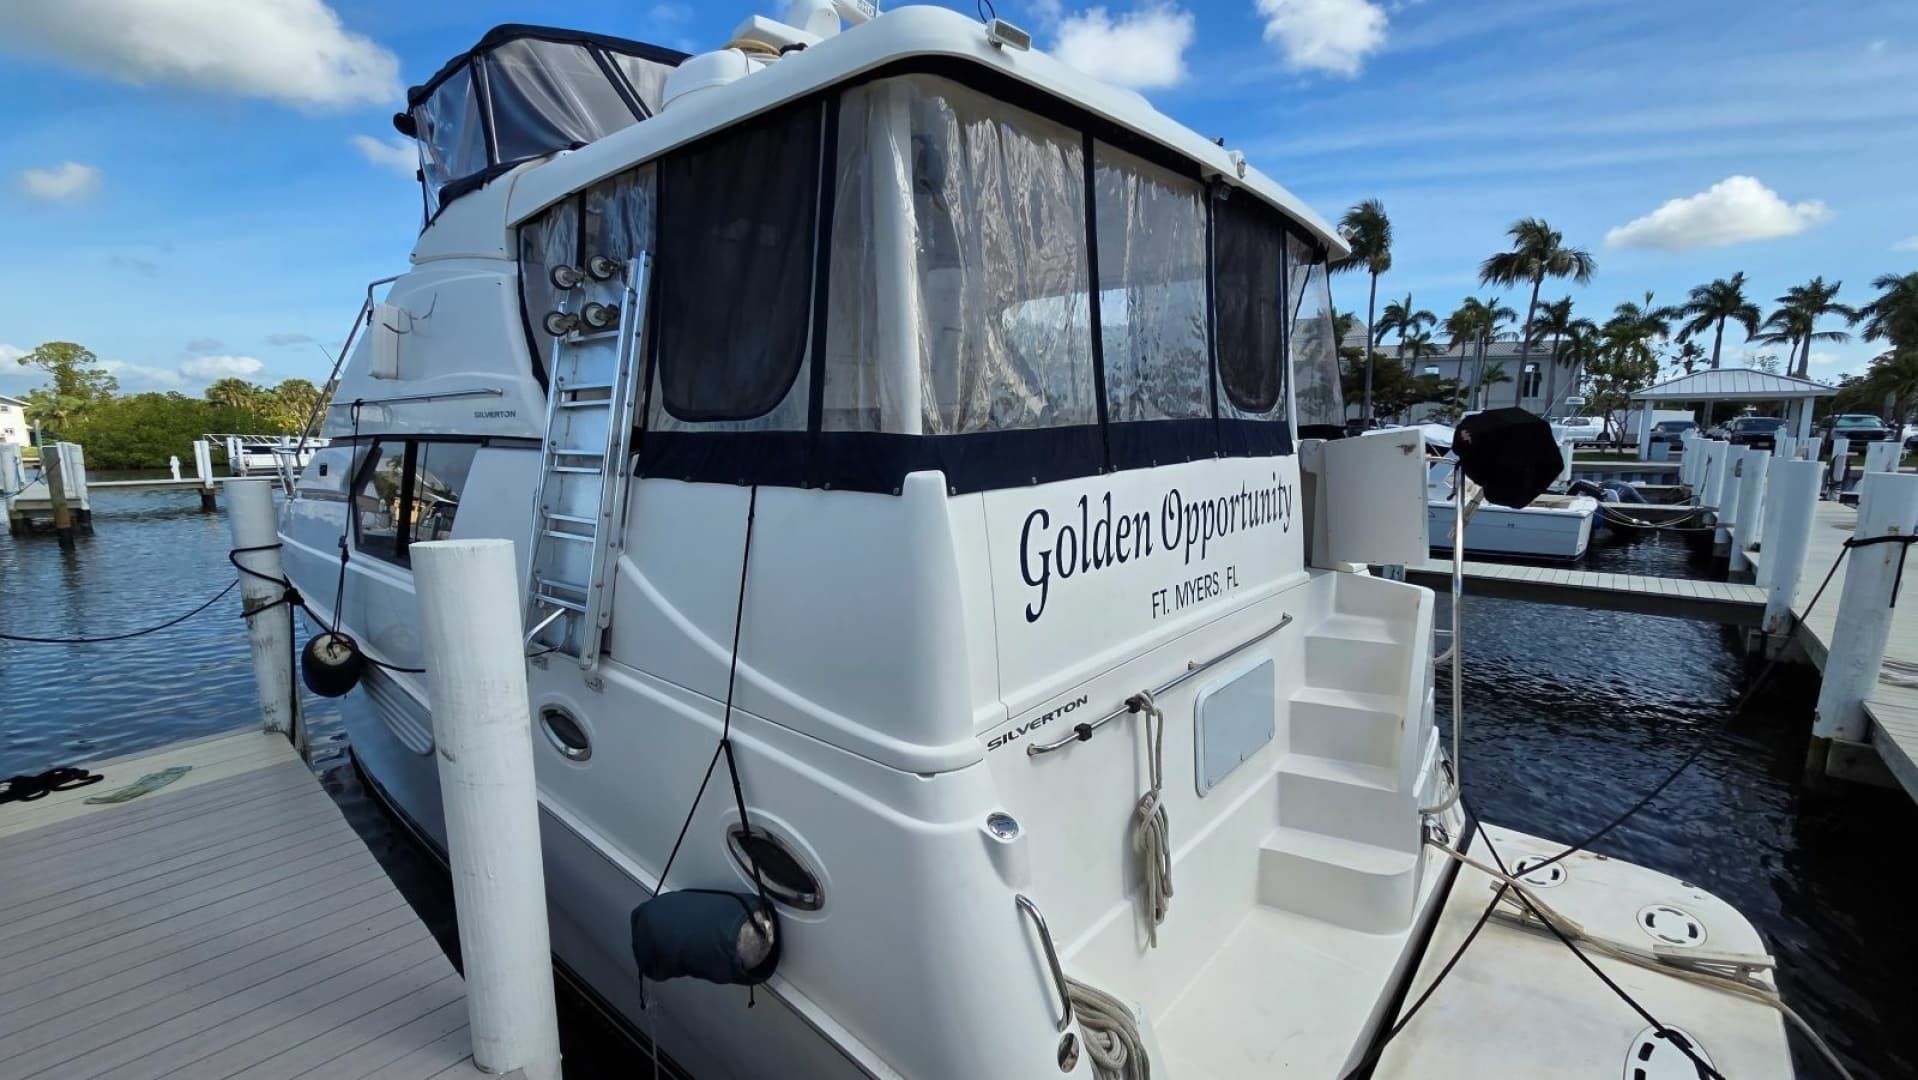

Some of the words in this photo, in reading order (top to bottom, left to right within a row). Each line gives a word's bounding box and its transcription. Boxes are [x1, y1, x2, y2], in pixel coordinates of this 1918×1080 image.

[473, 410, 517, 419] SILVERTON
[1019, 490, 1154, 623] Golden
[1160, 471, 1293, 565] Opportunity
[1151, 588, 1170, 619] FT.
[1175, 571, 1223, 610] MYERS,
[1226, 564, 1240, 591] FL
[986, 694, 1089, 752] SILVERTON
